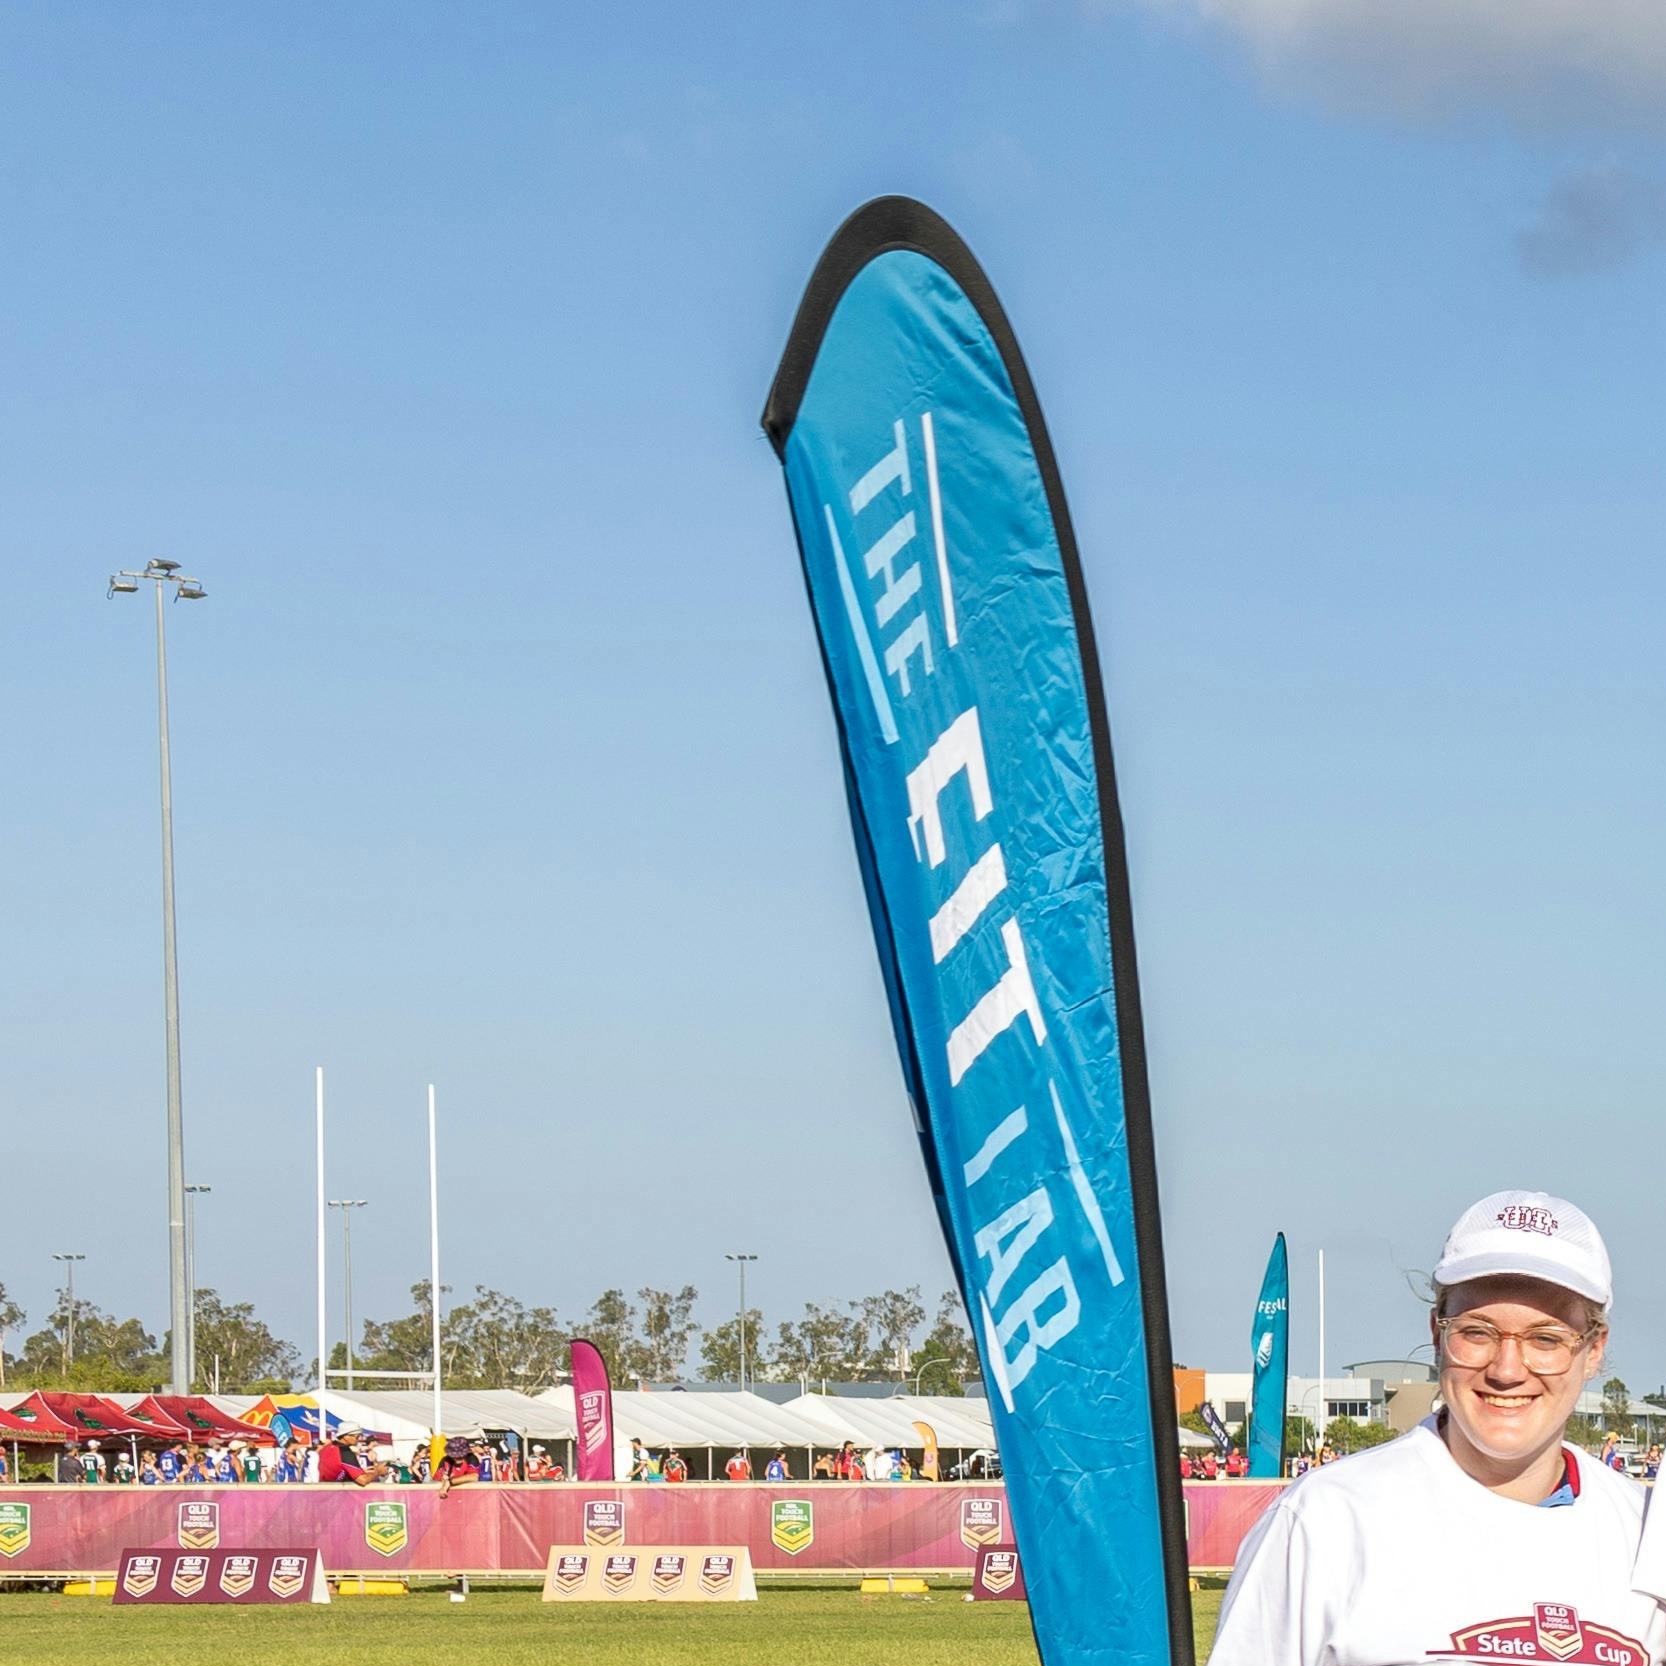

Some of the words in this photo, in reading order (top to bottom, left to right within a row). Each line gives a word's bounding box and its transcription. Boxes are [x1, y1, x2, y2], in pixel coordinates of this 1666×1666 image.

[849, 419, 934, 697] THE
[188, 1505, 208, 1514] QLD
[594, 1504, 615, 1513] QLD
[971, 1502, 992, 1511] QLD
[1544, 1607, 1567, 1617] QLD
[1477, 1634, 1536, 1656] State
